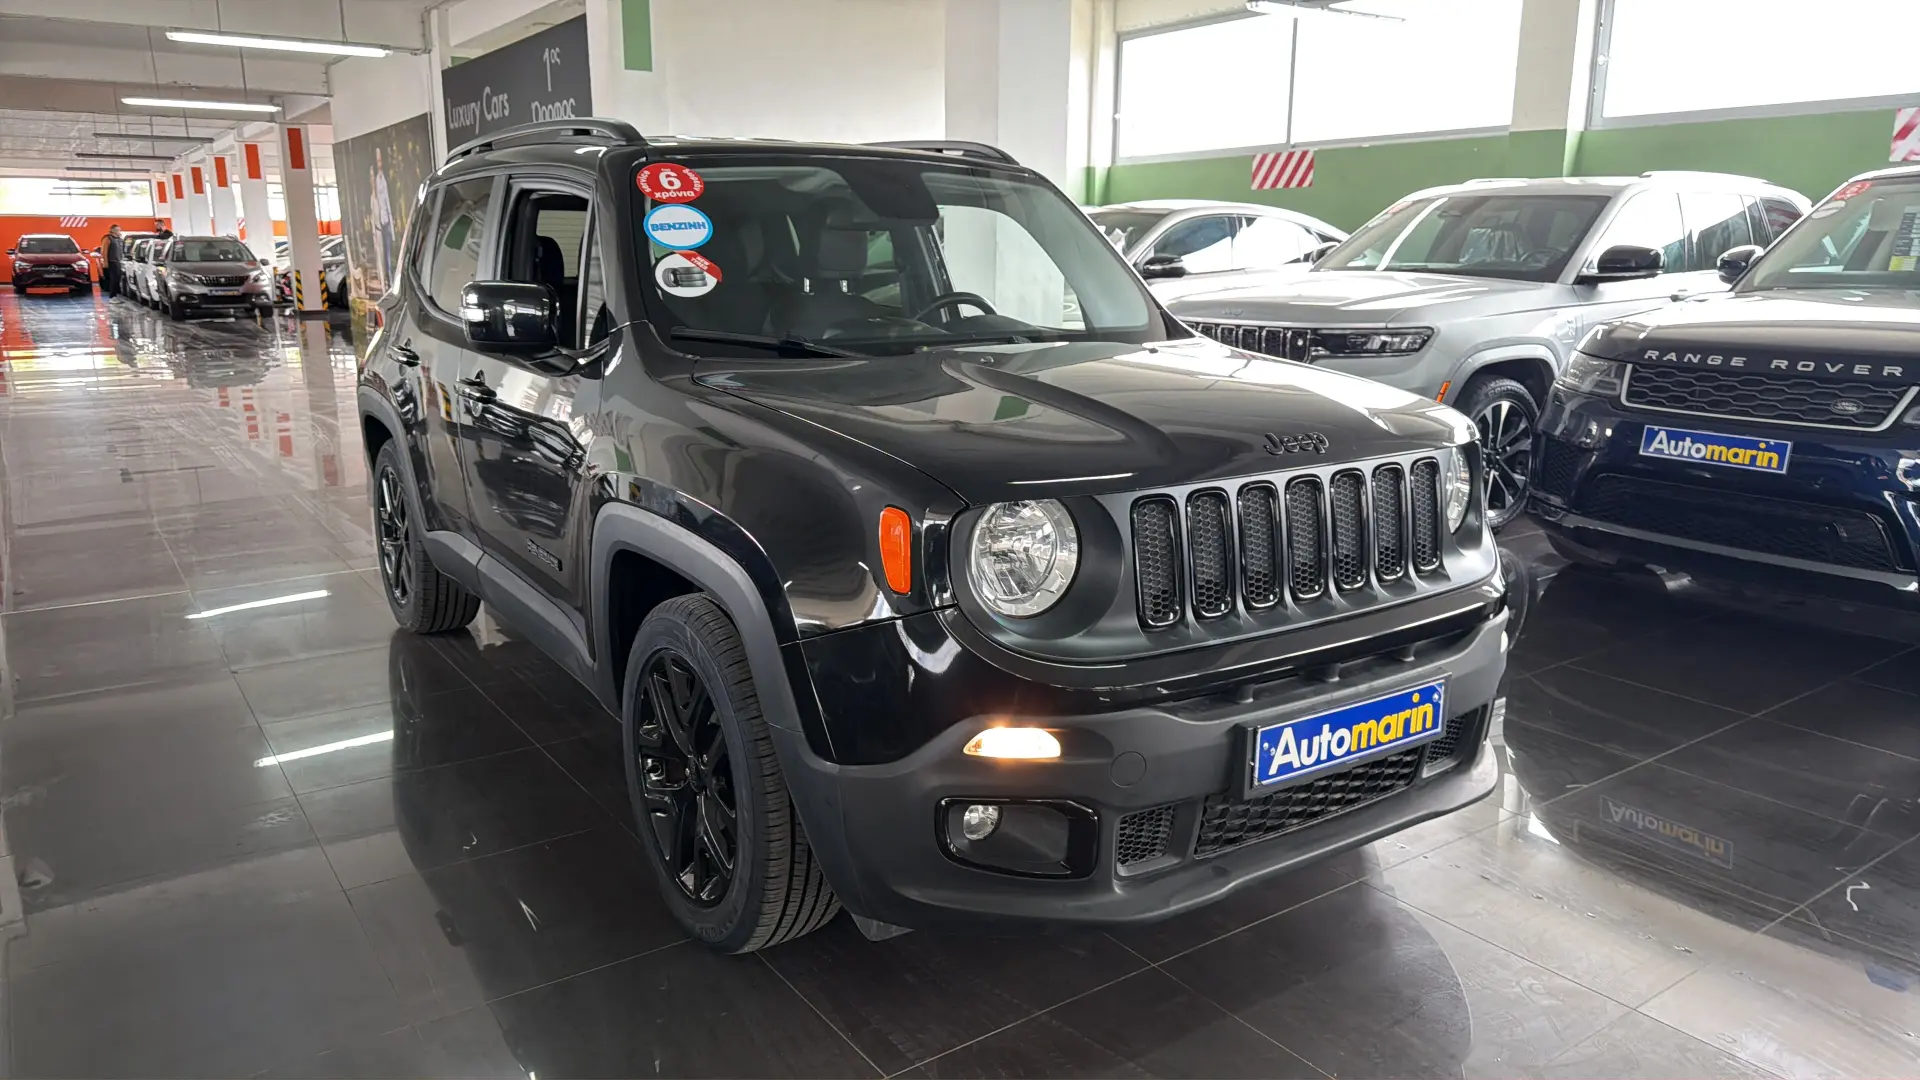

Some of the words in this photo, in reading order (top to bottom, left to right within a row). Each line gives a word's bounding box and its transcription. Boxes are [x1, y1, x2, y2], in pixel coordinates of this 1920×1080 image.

[447, 98, 480, 135] Luxury
[483, 86, 510, 121] Cars
[658, 171, 682, 190] 6
[654, 190, 696, 200] χρόνια
[1644, 350, 1747, 367] RANGE
[1770, 359, 1904, 377] ROVER
[1263, 432, 1329, 455] Jeep
[1648, 430, 1779, 469] Automarin
[1268, 692, 1434, 776] Automarin
